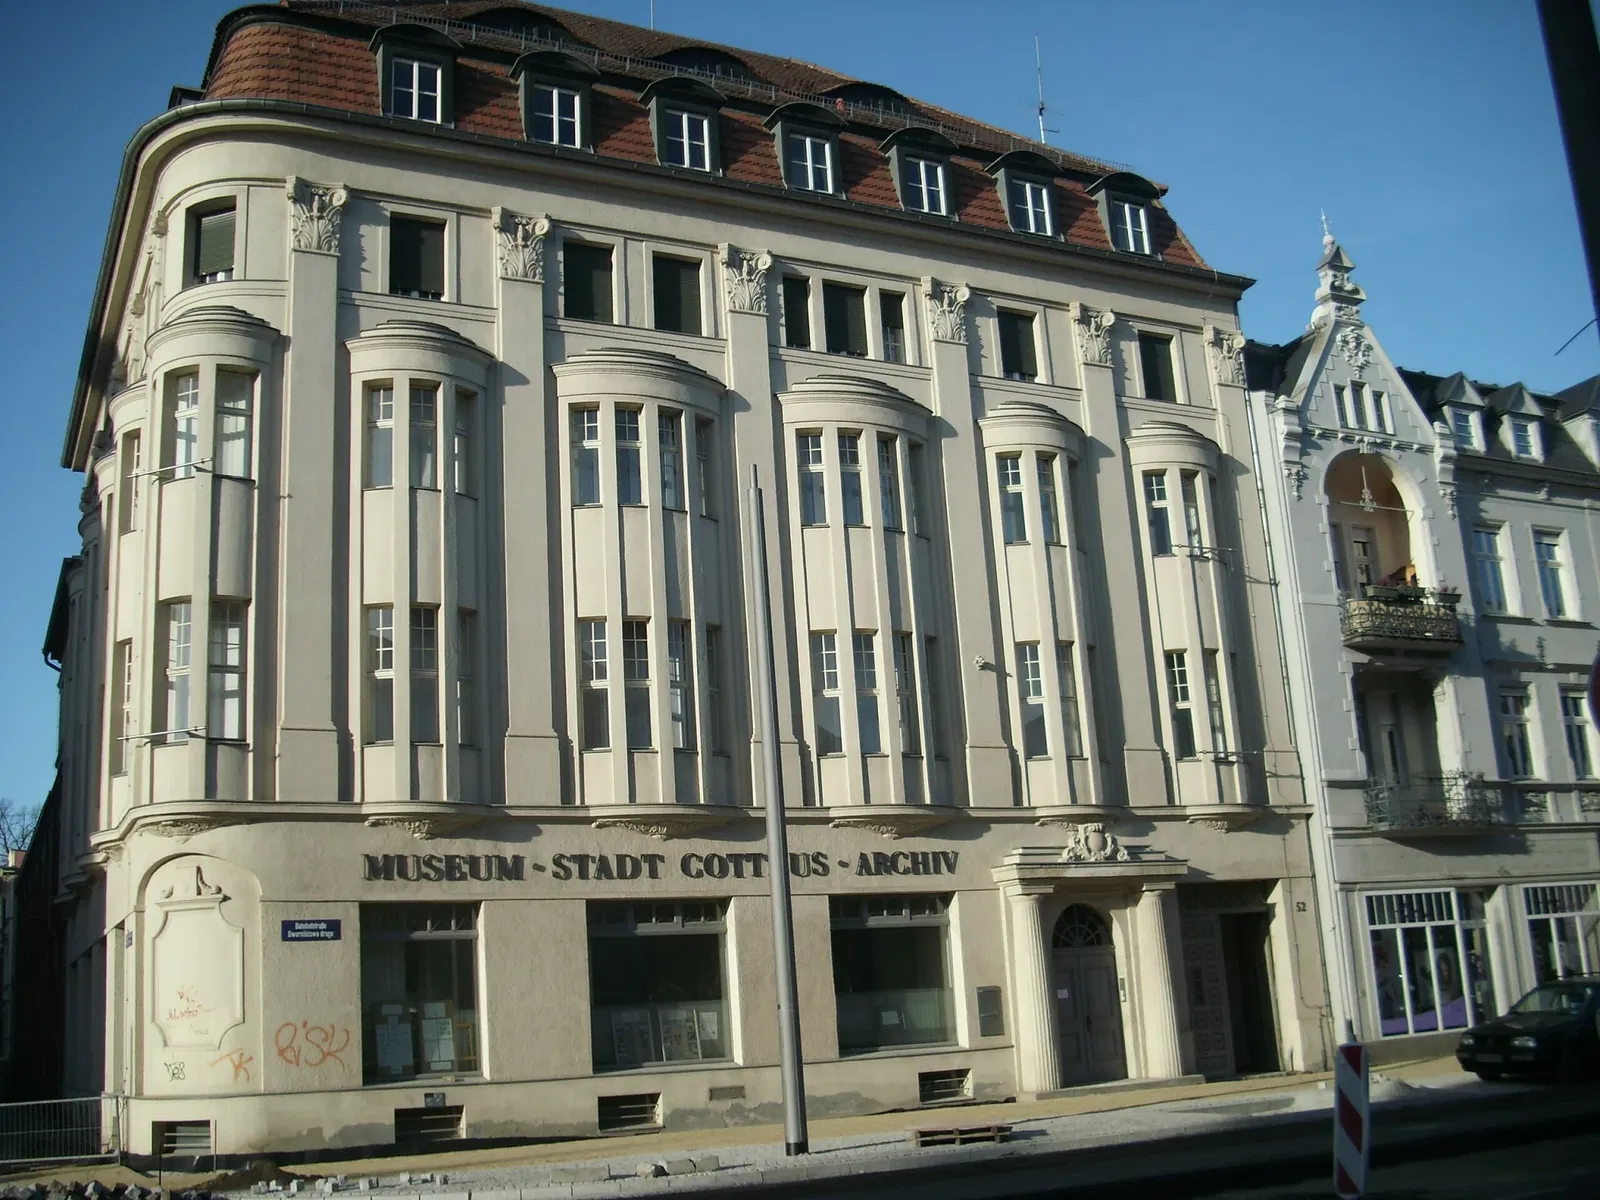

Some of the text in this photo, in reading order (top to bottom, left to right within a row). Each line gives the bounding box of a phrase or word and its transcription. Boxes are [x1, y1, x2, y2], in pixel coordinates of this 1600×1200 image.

[361, 853, 527, 881] MUSEUM
[552, 852, 665, 880] STADT
[680, 851, 830, 878] COTTUS
[855, 851, 960, 876] ARCHIV
[1296, 901, 1307, 912] 52
